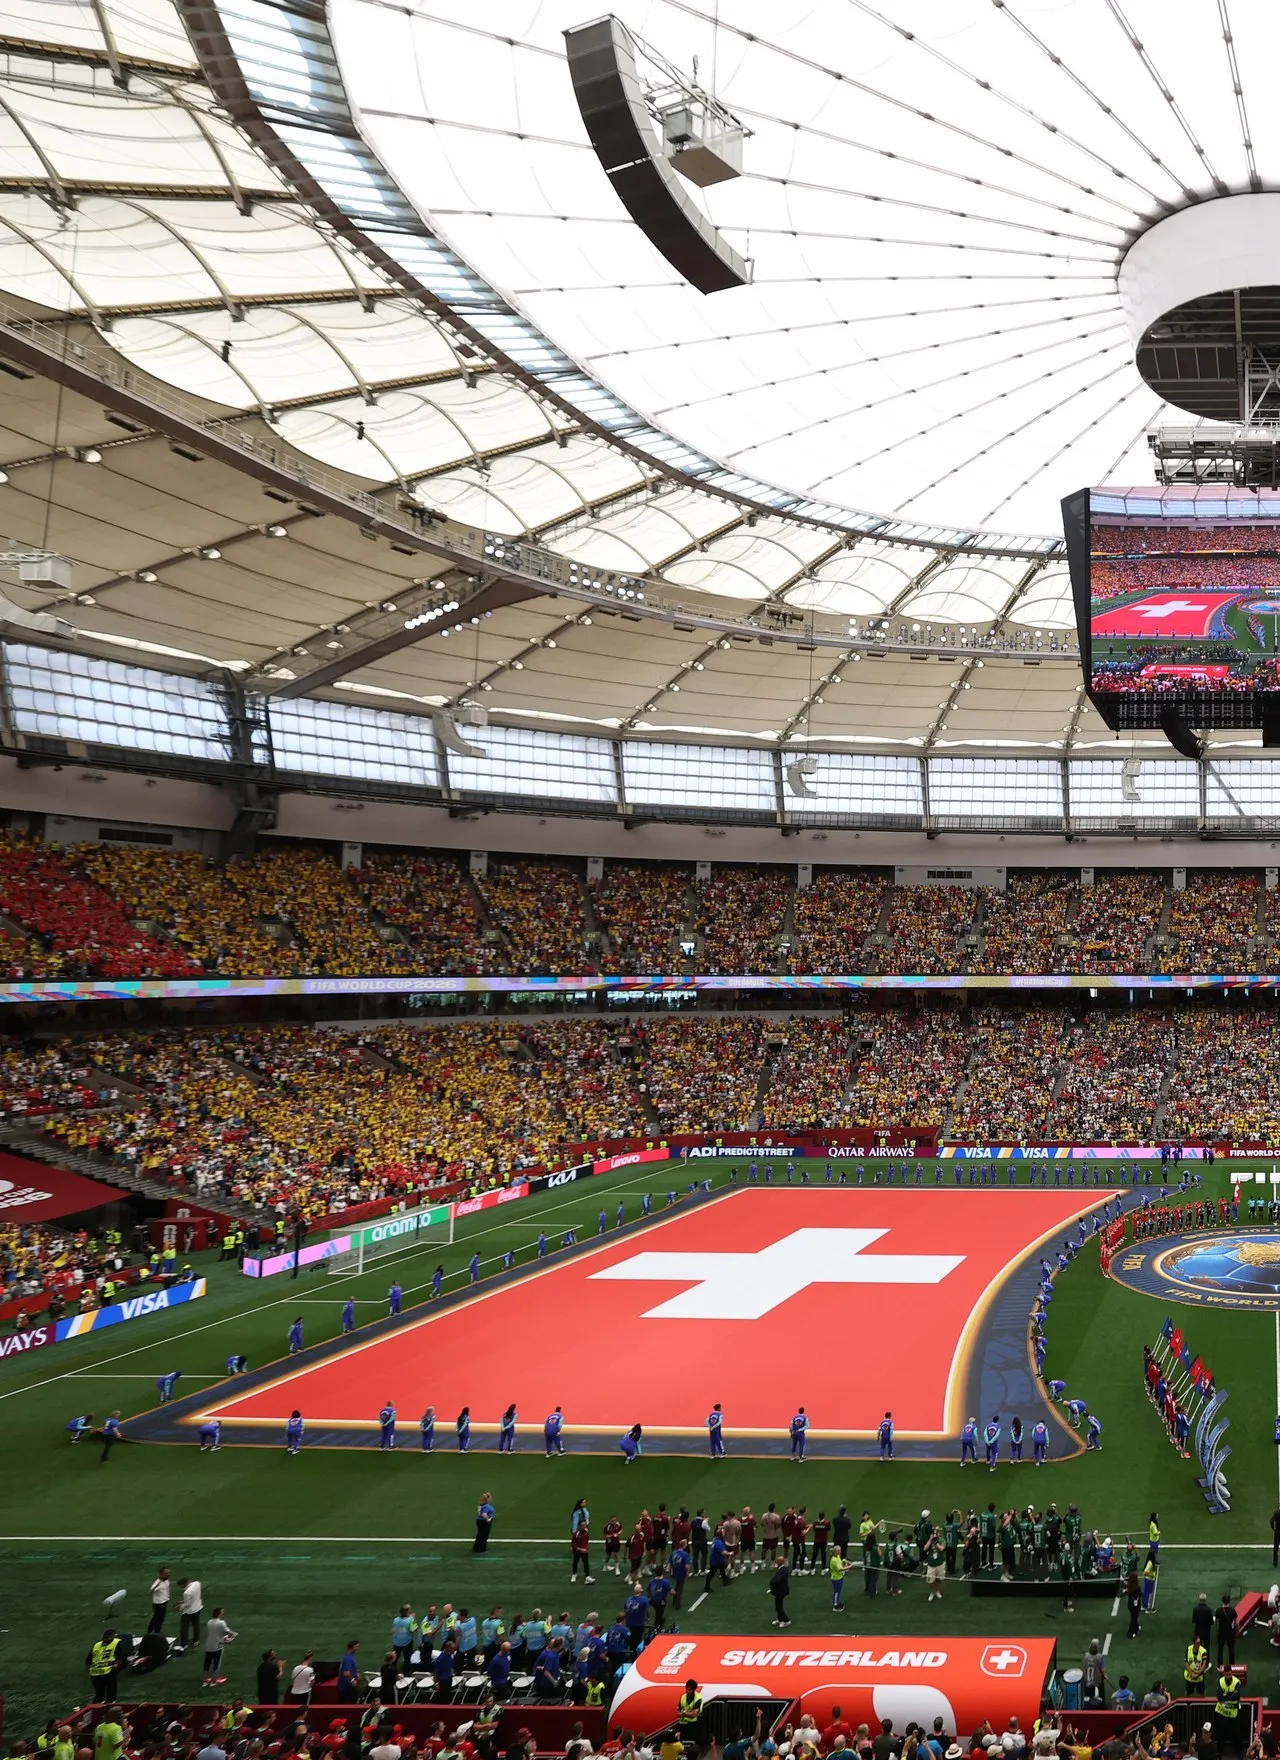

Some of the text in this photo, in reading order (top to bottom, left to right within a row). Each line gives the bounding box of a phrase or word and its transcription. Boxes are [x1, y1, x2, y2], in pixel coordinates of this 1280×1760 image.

[310, 979, 457, 991] FIFA WORLD CUP 2026
[689, 1147, 795, 1158] ADI PREDICTSTREET
[828, 1147, 915, 1158] QATAR AIRWAYS
[962, 1147, 992, 1158] VISA
[1020, 1147, 1050, 1158] VISA
[610, 1153, 641, 1169] Lenovo
[547, 1169, 577, 1188] KIA
[1165, 1288, 1203, 1301] FIFA
[1206, 1295, 1279, 1306] WORLD
[117, 1289, 170, 1320] VISA
[720, 1650, 948, 1667] SWITZERLAND
